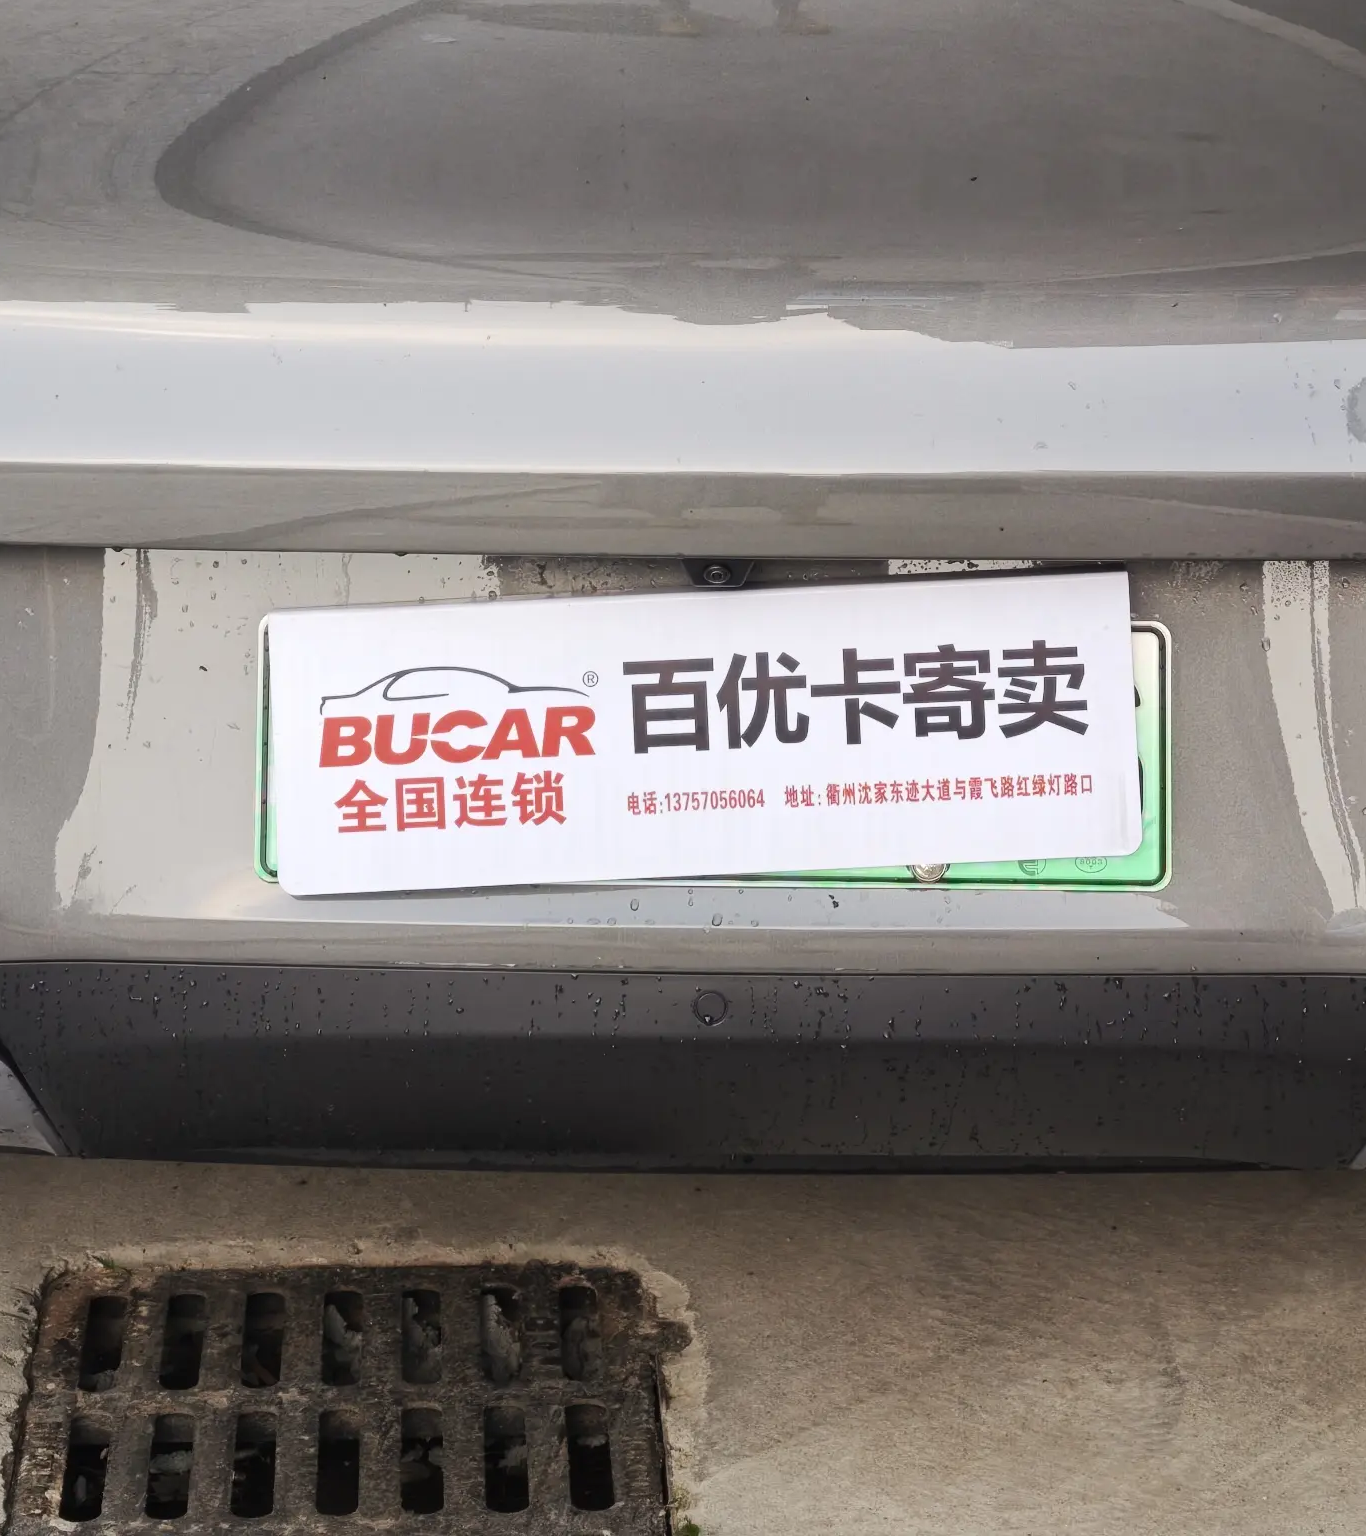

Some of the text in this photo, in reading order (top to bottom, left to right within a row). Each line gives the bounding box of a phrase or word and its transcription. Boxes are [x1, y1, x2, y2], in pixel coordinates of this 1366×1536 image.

[622, 639, 1089, 754] 百优卡寄卖
[319, 705, 597, 768] BUCAR
[333, 770, 568, 834] 全国连锁
